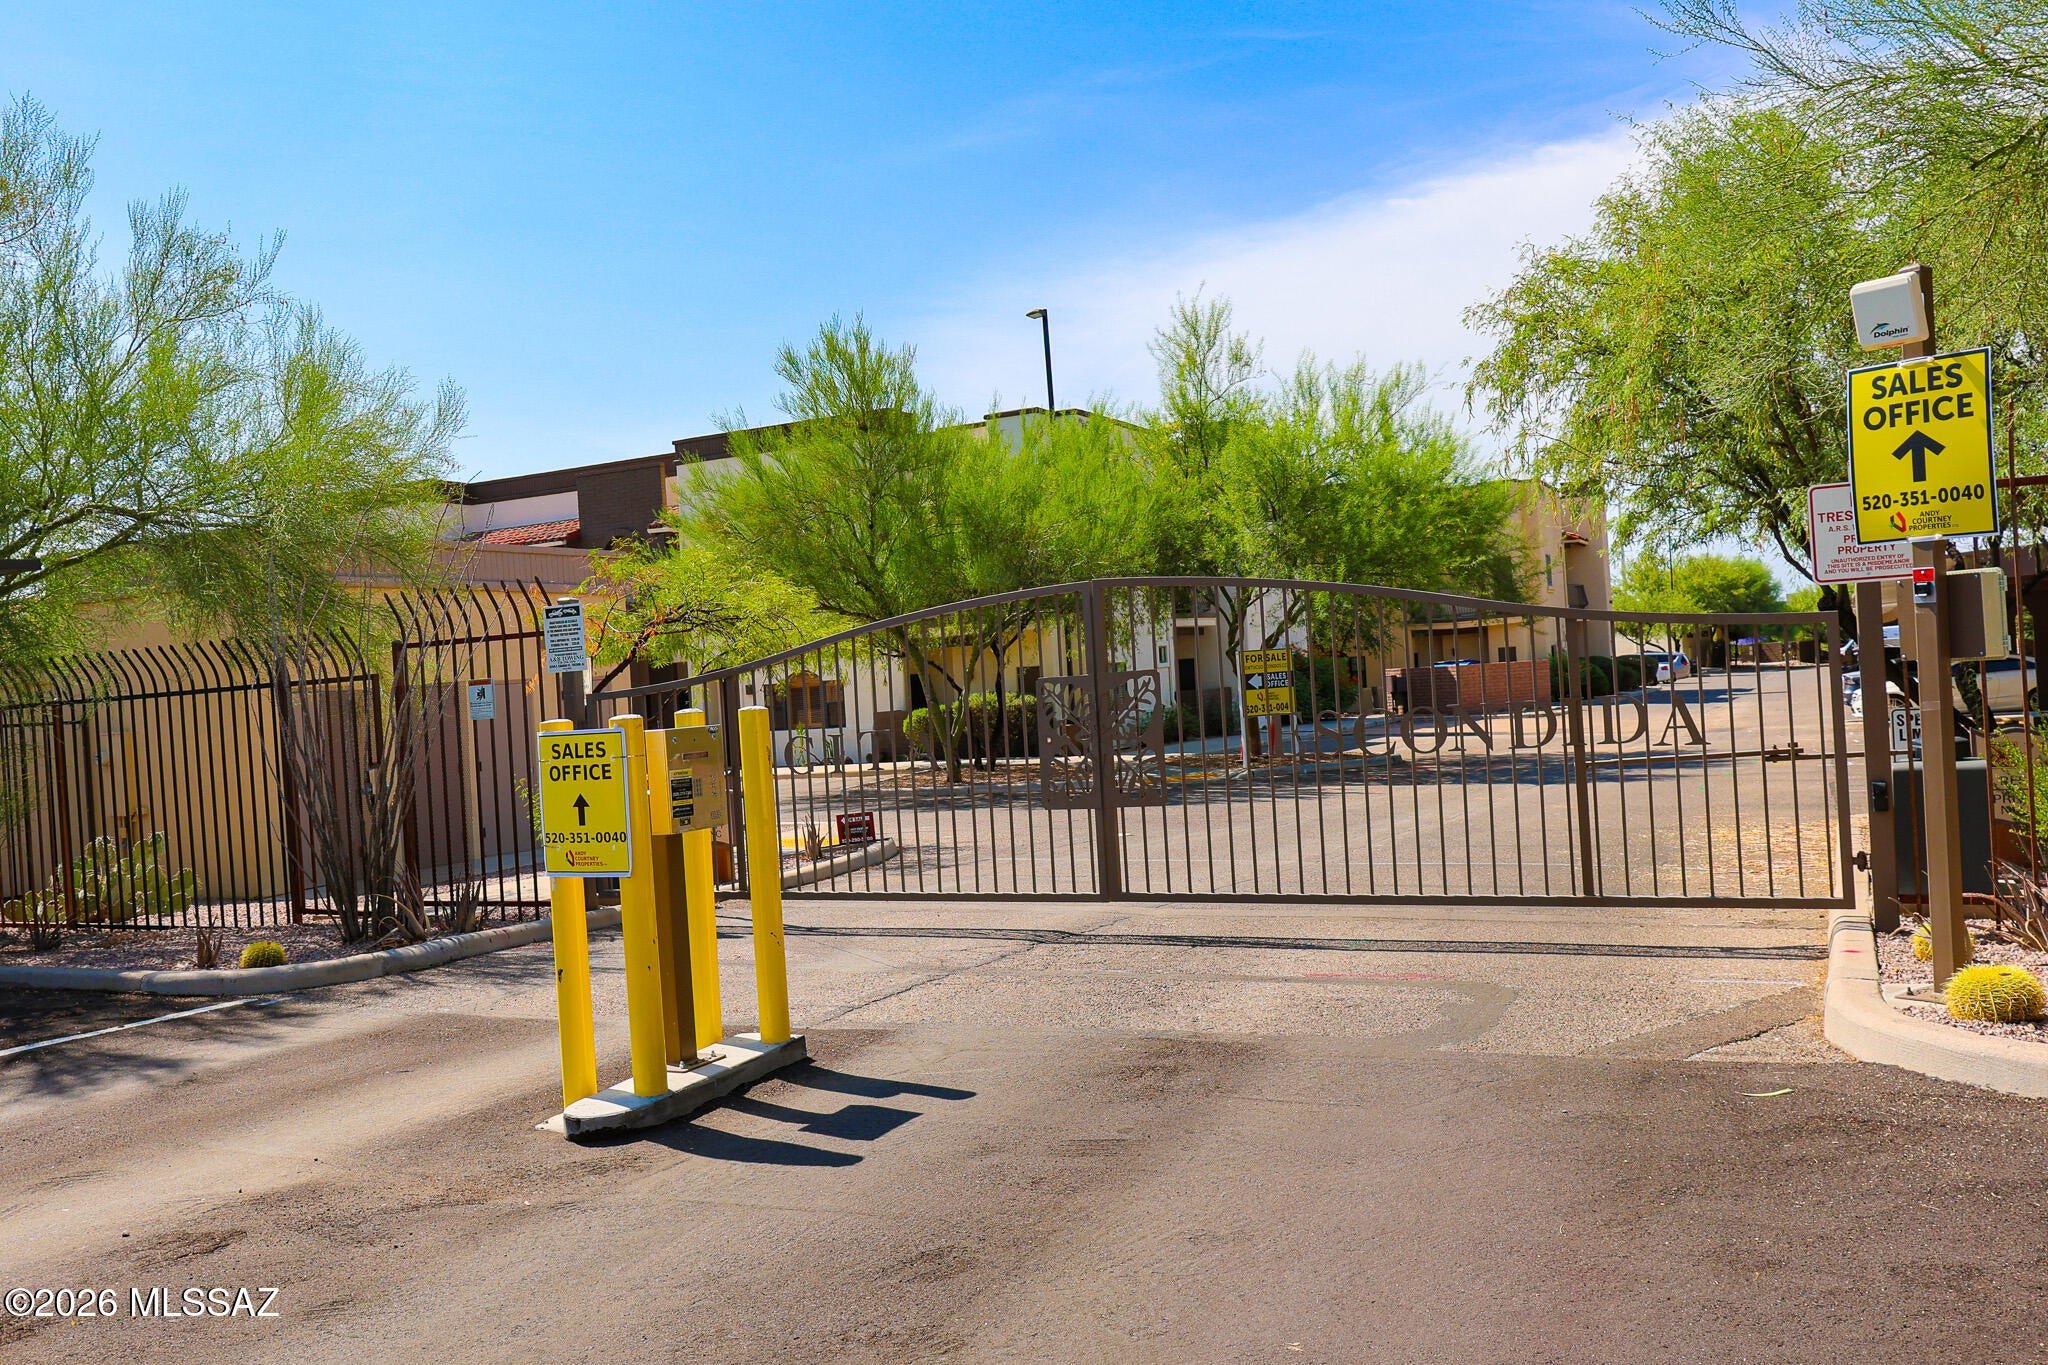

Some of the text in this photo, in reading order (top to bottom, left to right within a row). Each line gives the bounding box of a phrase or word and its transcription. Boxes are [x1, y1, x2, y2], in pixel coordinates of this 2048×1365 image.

[1874, 327, 1908, 338] Dolphin
[1872, 363, 1963, 400] SALES
[1863, 392, 1974, 431] OFFICE
[1862, 484, 1984, 511] 520-351-0040
[1912, 515, 1952, 525] COURTNEY
[1908, 522, 1951, 531] PROPERTIES
[1837, 544, 1896, 554] PROPERTY
[1831, 555, 1875, 563] UNAUTHORIZED
[1245, 653, 1286, 663] FOR SALE
[551, 741, 607, 760] SALES
[549, 763, 612, 782] OFFICE
[546, 832, 627, 844] 520-351-0040
